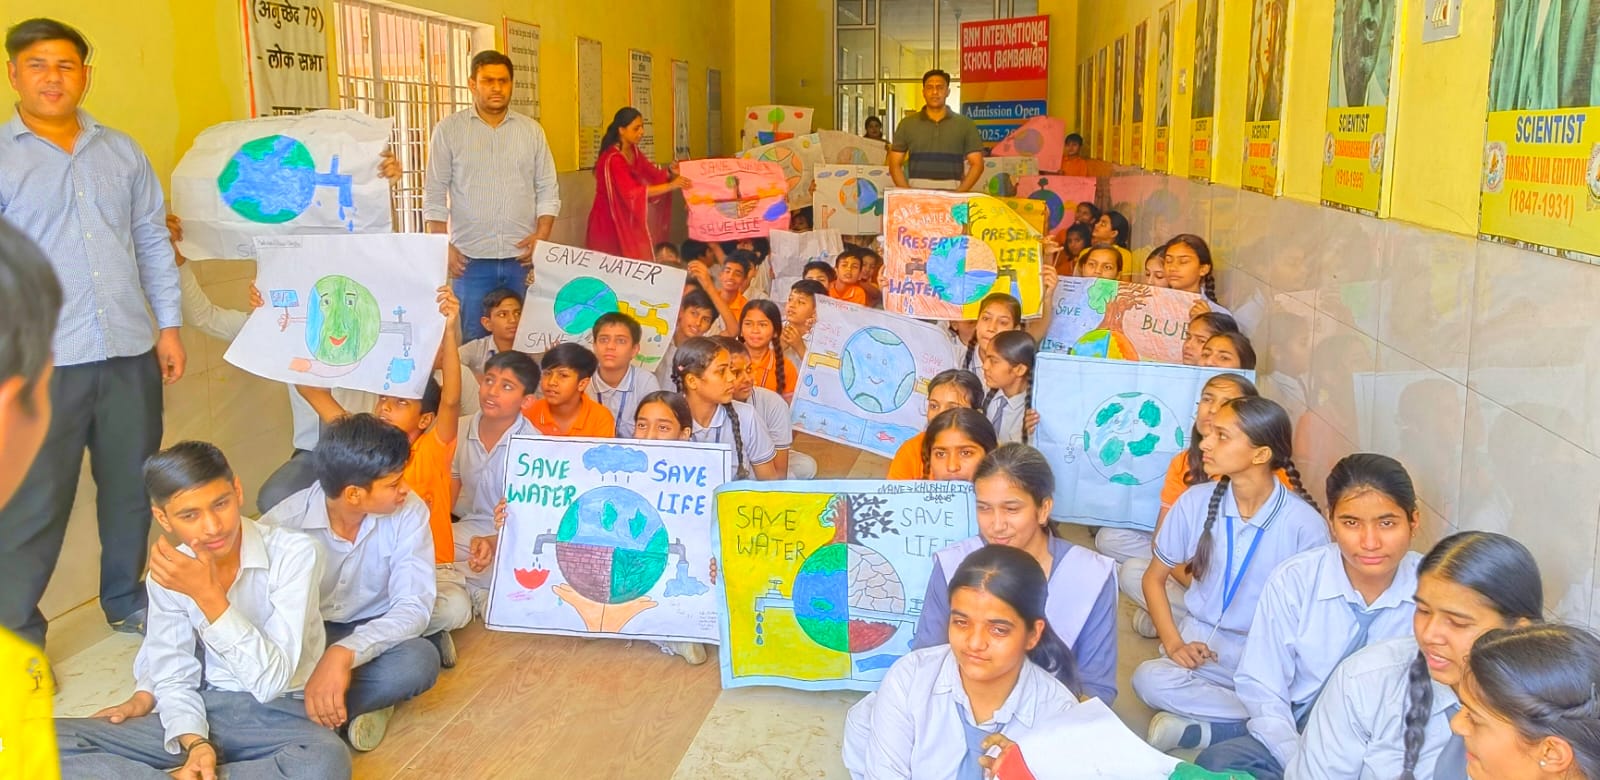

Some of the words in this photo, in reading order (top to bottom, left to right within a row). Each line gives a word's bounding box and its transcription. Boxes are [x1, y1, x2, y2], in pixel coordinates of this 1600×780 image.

[303, 6, 324, 32] 79)
[982, 20, 1048, 47] INTERNATIONAL
[266, 43, 294, 69] लोक
[298, 53, 324, 72] सभा
[963, 51, 992, 72] SCHOOL
[994, 46, 1047, 72] (BAMBAWAR)
[966, 104, 1012, 118] Admission
[1015, 103, 1040, 119] Open
[1339, 113, 1370, 133] SCIENTIST
[1516, 114, 1586, 144] SCIENTIST
[1505, 155, 1530, 181] TOMAS
[1530, 157, 1550, 184] ALVA
[1551, 157, 1588, 187] EDITION
[1509, 188, 1575, 227] (1847-1931)
[700, 221, 732, 234] SAVE
[735, 217, 760, 231] LIFE
[898, 226, 970, 250] PRESERVE
[545, 246, 595, 268] SAVE
[599, 256, 662, 285] WATER
[1000, 248, 1037, 263] LIFE
[889, 277, 946, 300] WATER
[1055, 297, 1081, 317] SAVE
[515, 452, 570, 480] SAVE
[651, 459, 708, 487] SAVE
[506, 483, 577, 508] WATER
[656, 491, 707, 515] LIFE
[735, 505, 797, 532] SAVE
[899, 507, 955, 528] SAVE
[736, 532, 807, 561] WATER
